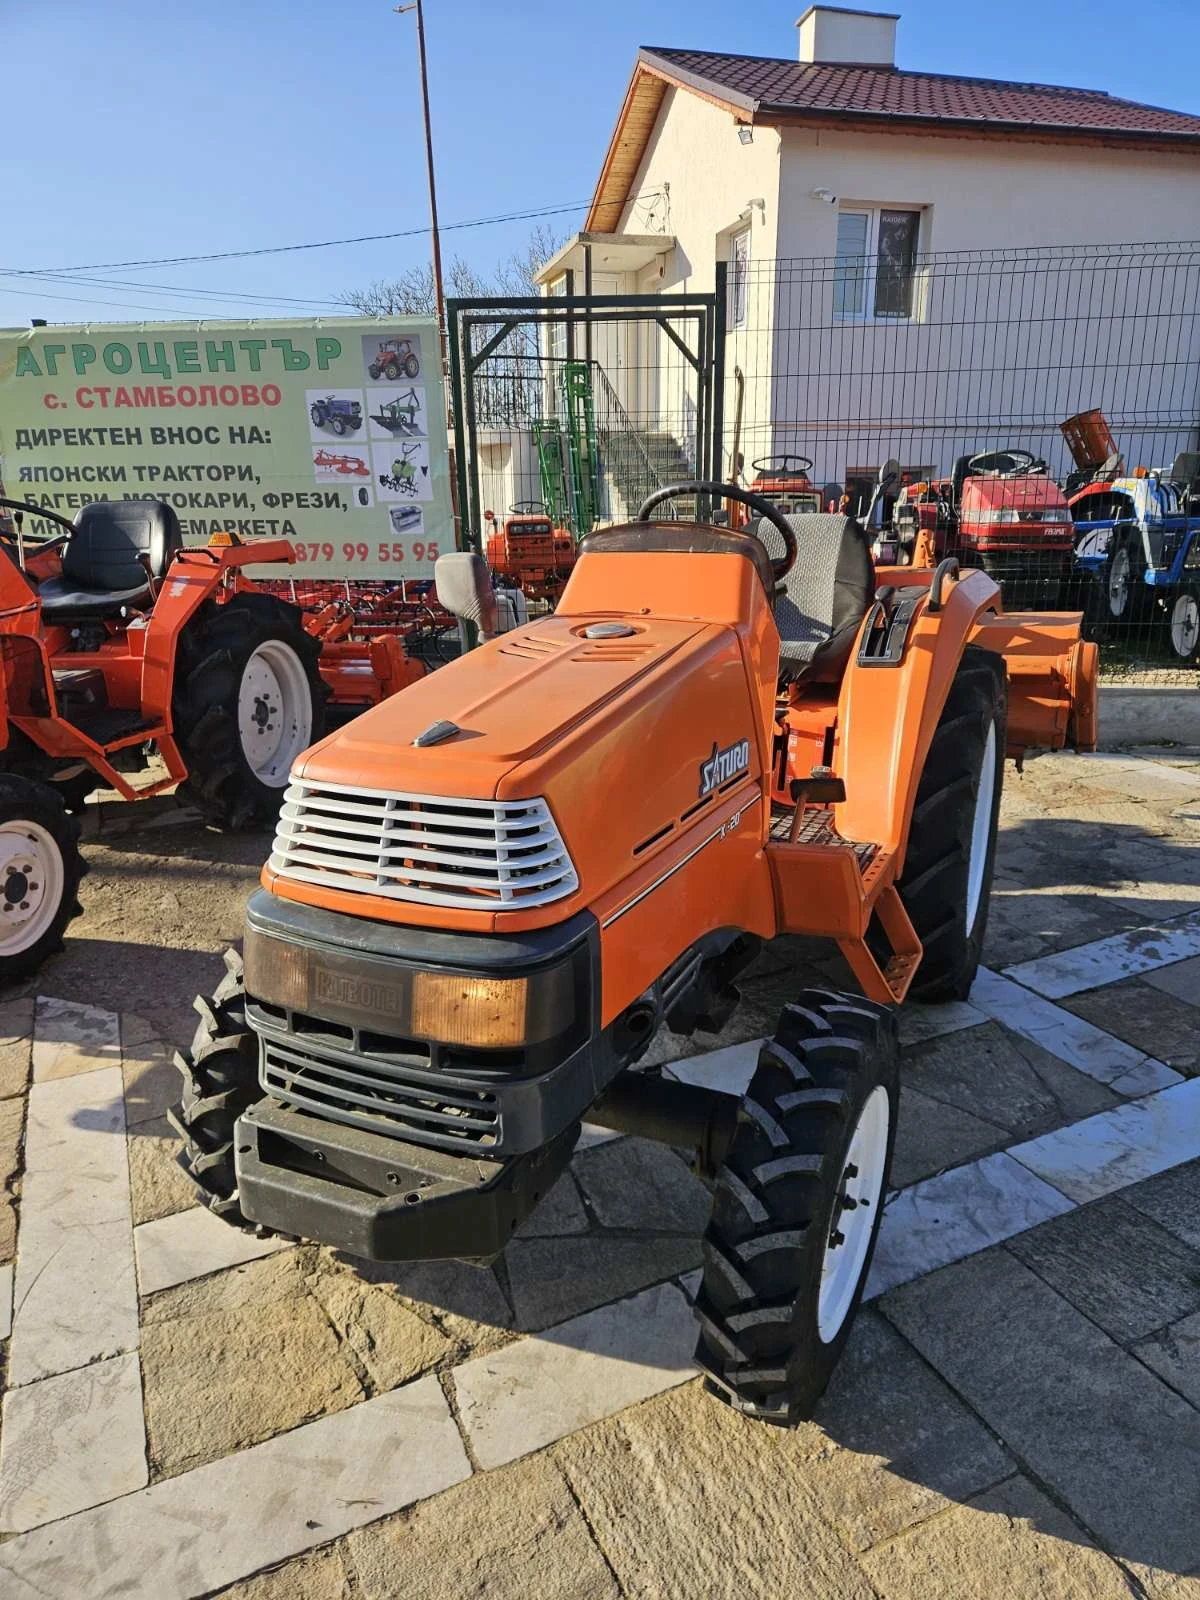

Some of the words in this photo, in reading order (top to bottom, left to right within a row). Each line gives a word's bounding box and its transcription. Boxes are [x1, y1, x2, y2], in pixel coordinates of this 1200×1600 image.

[16, 337, 342, 379] АГРОЦЕНТЪР
[43, 393, 68, 409] с.
[75, 383, 282, 409] СТАМБОЛОВО
[15, 427, 142, 450] ДИРЕКТЕН
[150, 426, 220, 445] ВНОС
[228, 425, 272, 444] НА:
[19, 465, 127, 482] ЯПОНСКИ
[133, 464, 261, 485] ТРАКТОРИ,
[262, 492, 348, 512] ФРЕЗИ,
[178, 519, 297, 536] ЕМАРКЕТА
[342, 542, 369, 562] 99
[378, 542, 405, 562] 55
[412, 541, 440, 562] 95
